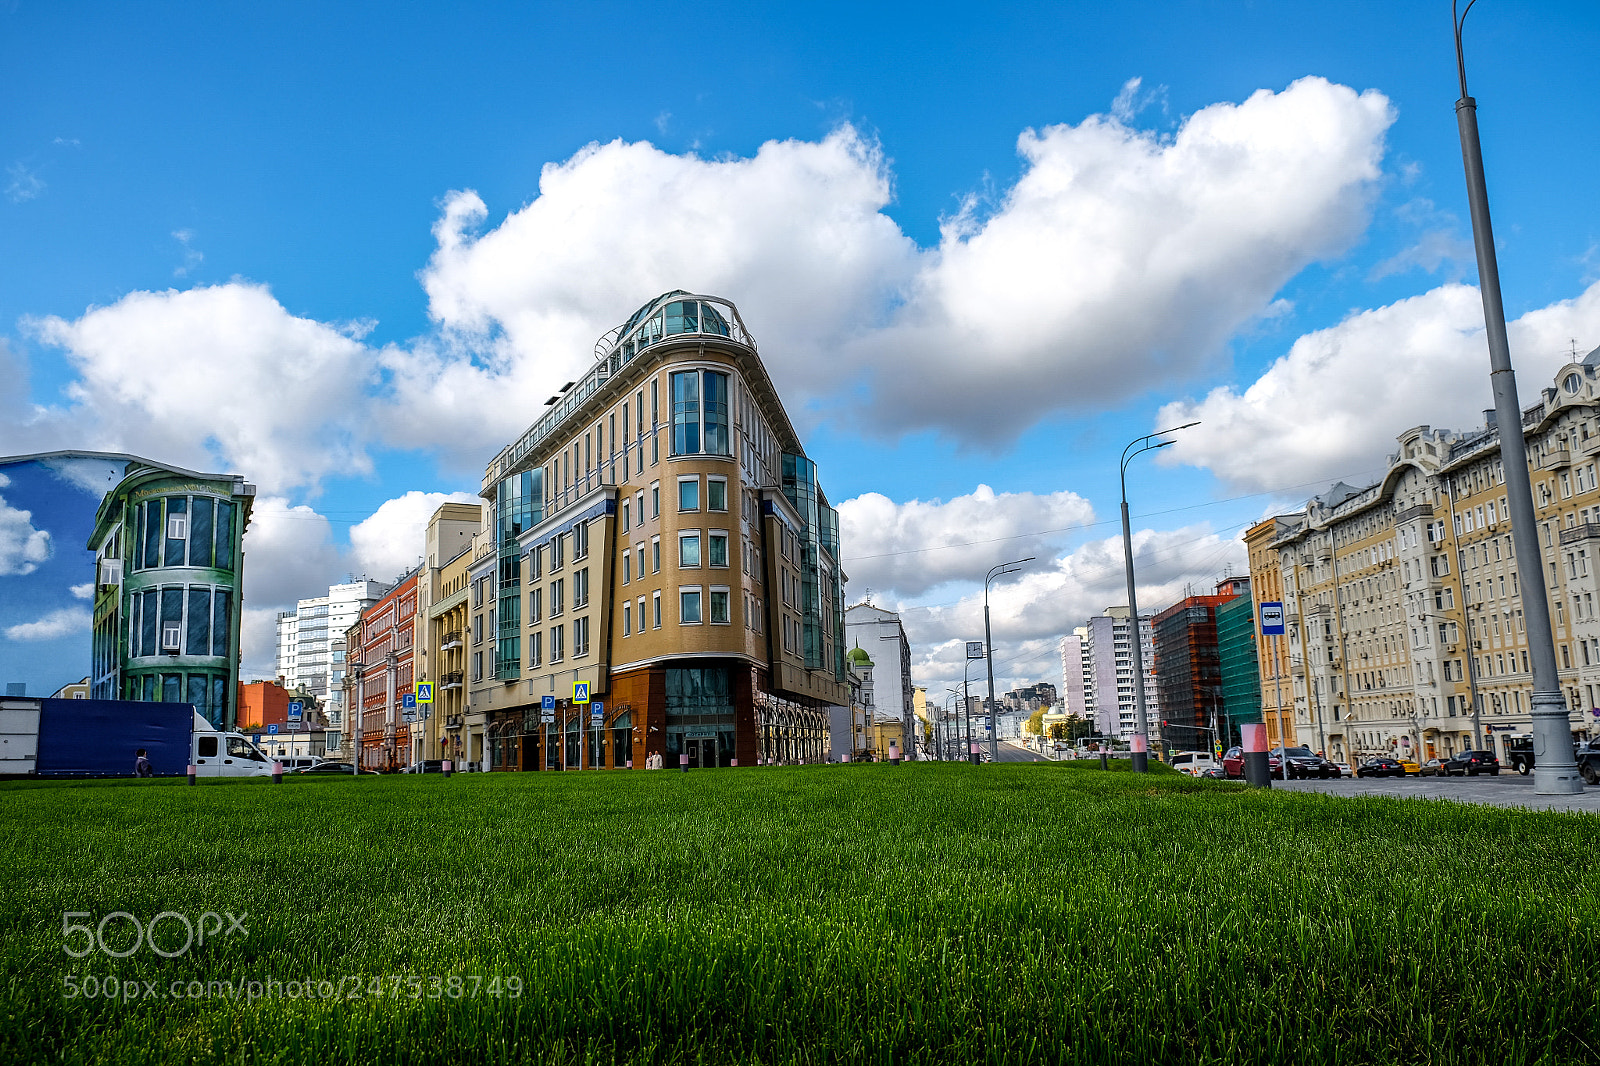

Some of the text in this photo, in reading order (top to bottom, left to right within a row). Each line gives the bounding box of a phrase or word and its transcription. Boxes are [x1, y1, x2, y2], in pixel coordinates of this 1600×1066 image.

[406, 695, 414, 706] P
[544, 697, 552, 707] P
[291, 704, 300, 714] P
[594, 704, 601, 713] P
[270, 726, 276, 734] P
